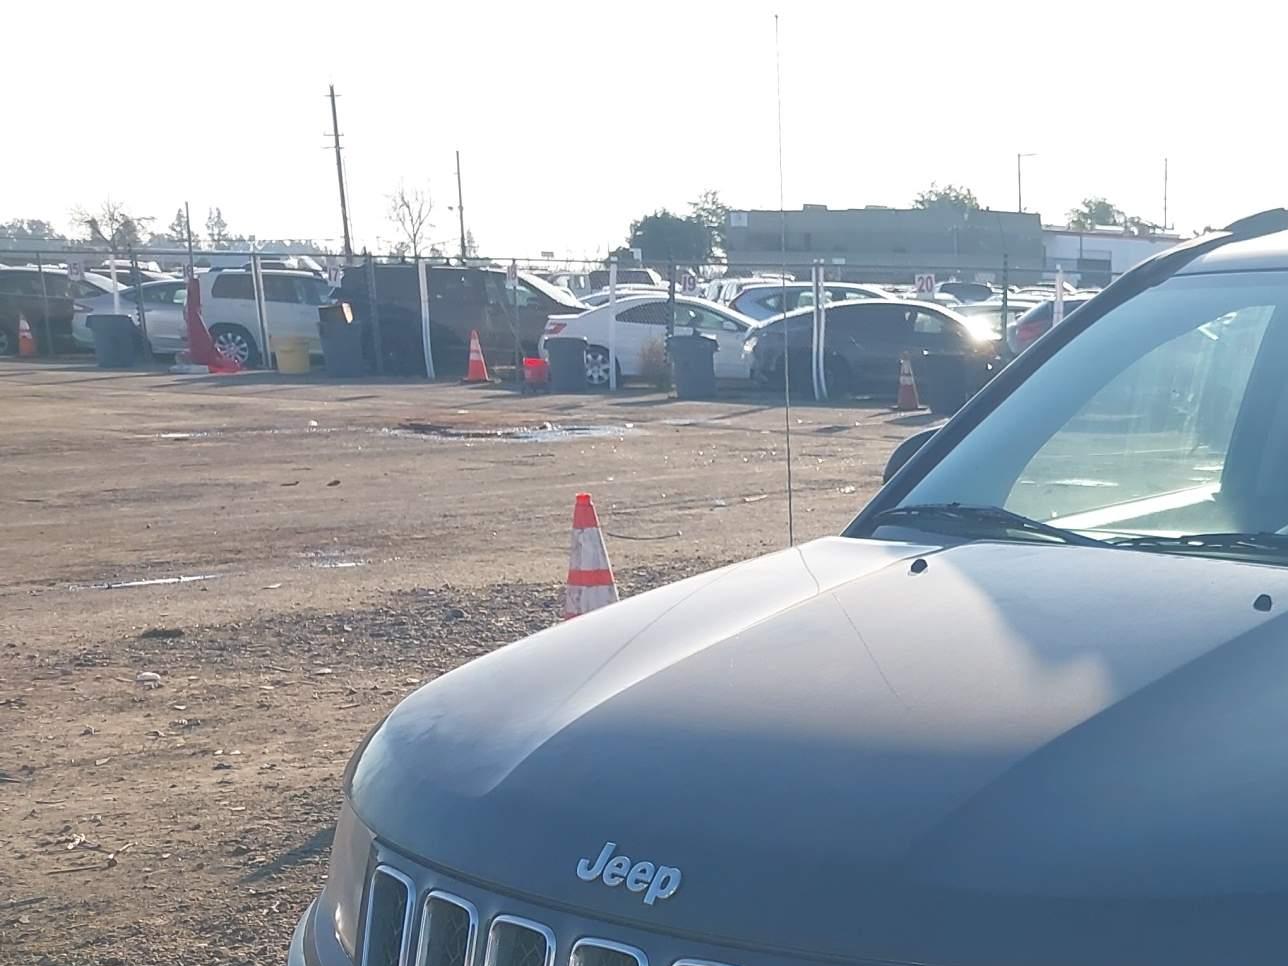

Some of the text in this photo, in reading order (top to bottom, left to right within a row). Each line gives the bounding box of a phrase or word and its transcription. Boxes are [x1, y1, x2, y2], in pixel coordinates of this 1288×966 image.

[682, 275, 697, 292] 19
[916, 275, 934, 293] 20
[576, 841, 682, 906] Jeep
